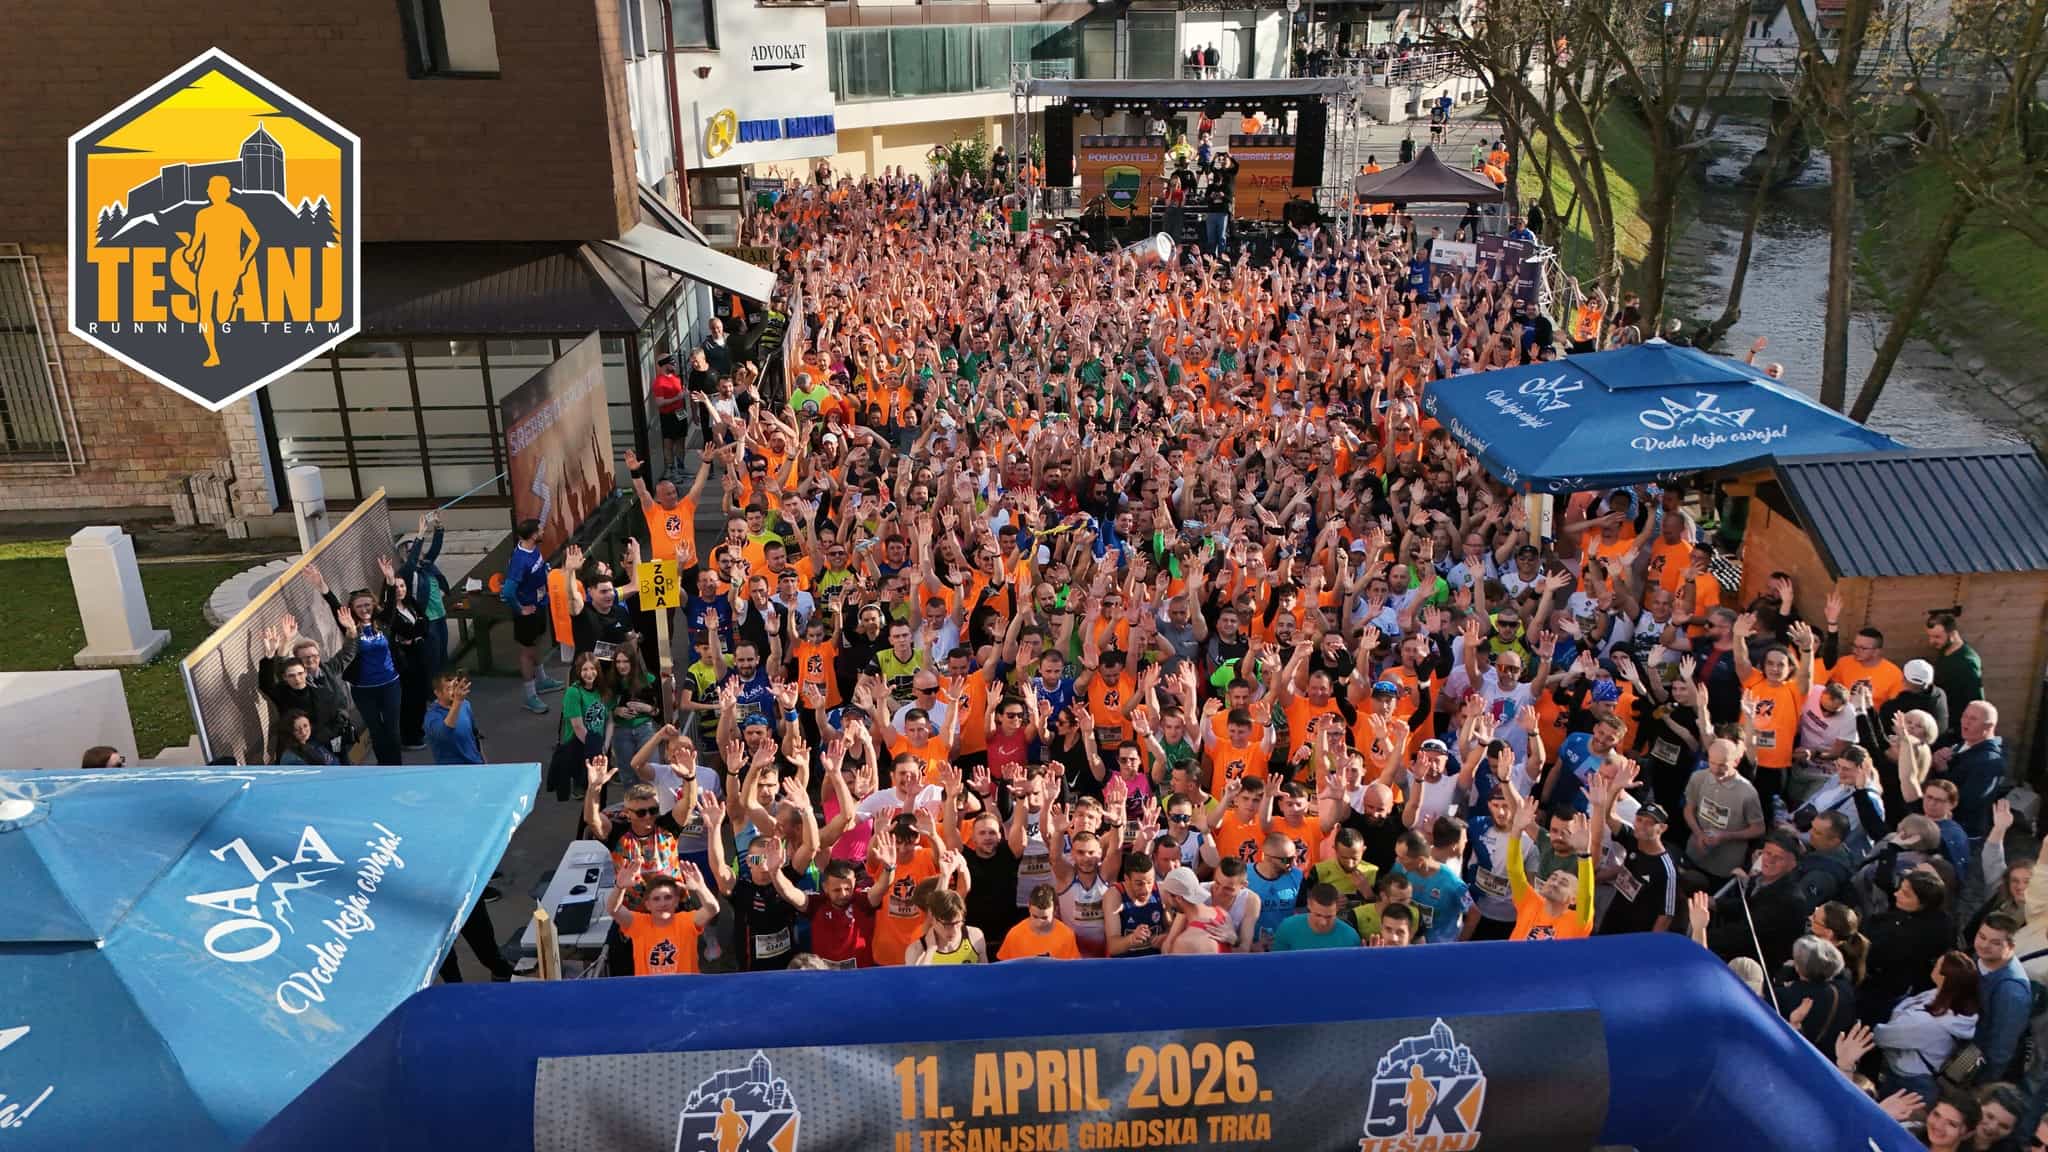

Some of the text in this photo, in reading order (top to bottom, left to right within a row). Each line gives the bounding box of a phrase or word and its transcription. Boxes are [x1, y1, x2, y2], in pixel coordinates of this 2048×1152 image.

[751, 44, 807, 61] ADVOKAT
[737, 115, 835, 143] NOVA BANKA
[1639, 391, 1755, 430] OAZA
[1631, 424, 1788, 451] Voda koja osvaja!
[654, 564, 666, 607] ZONA
[807, 661, 822, 673] 5K
[186, 825, 344, 962] OAZA
[276, 822, 405, 1015] Voda koja osvaja!
[650, 950, 676, 966] 5K
[894, 1040, 1273, 1120] 11. APRIL 2026.
[1364, 1077, 1487, 1138] 5K
[674, 1110, 801, 1152] 5K
[919, 1121, 1070, 1152] TEŠANJSKA
[1079, 1117, 1198, 1150] GRADSKA
[1207, 1112, 1272, 1145] TRKA
